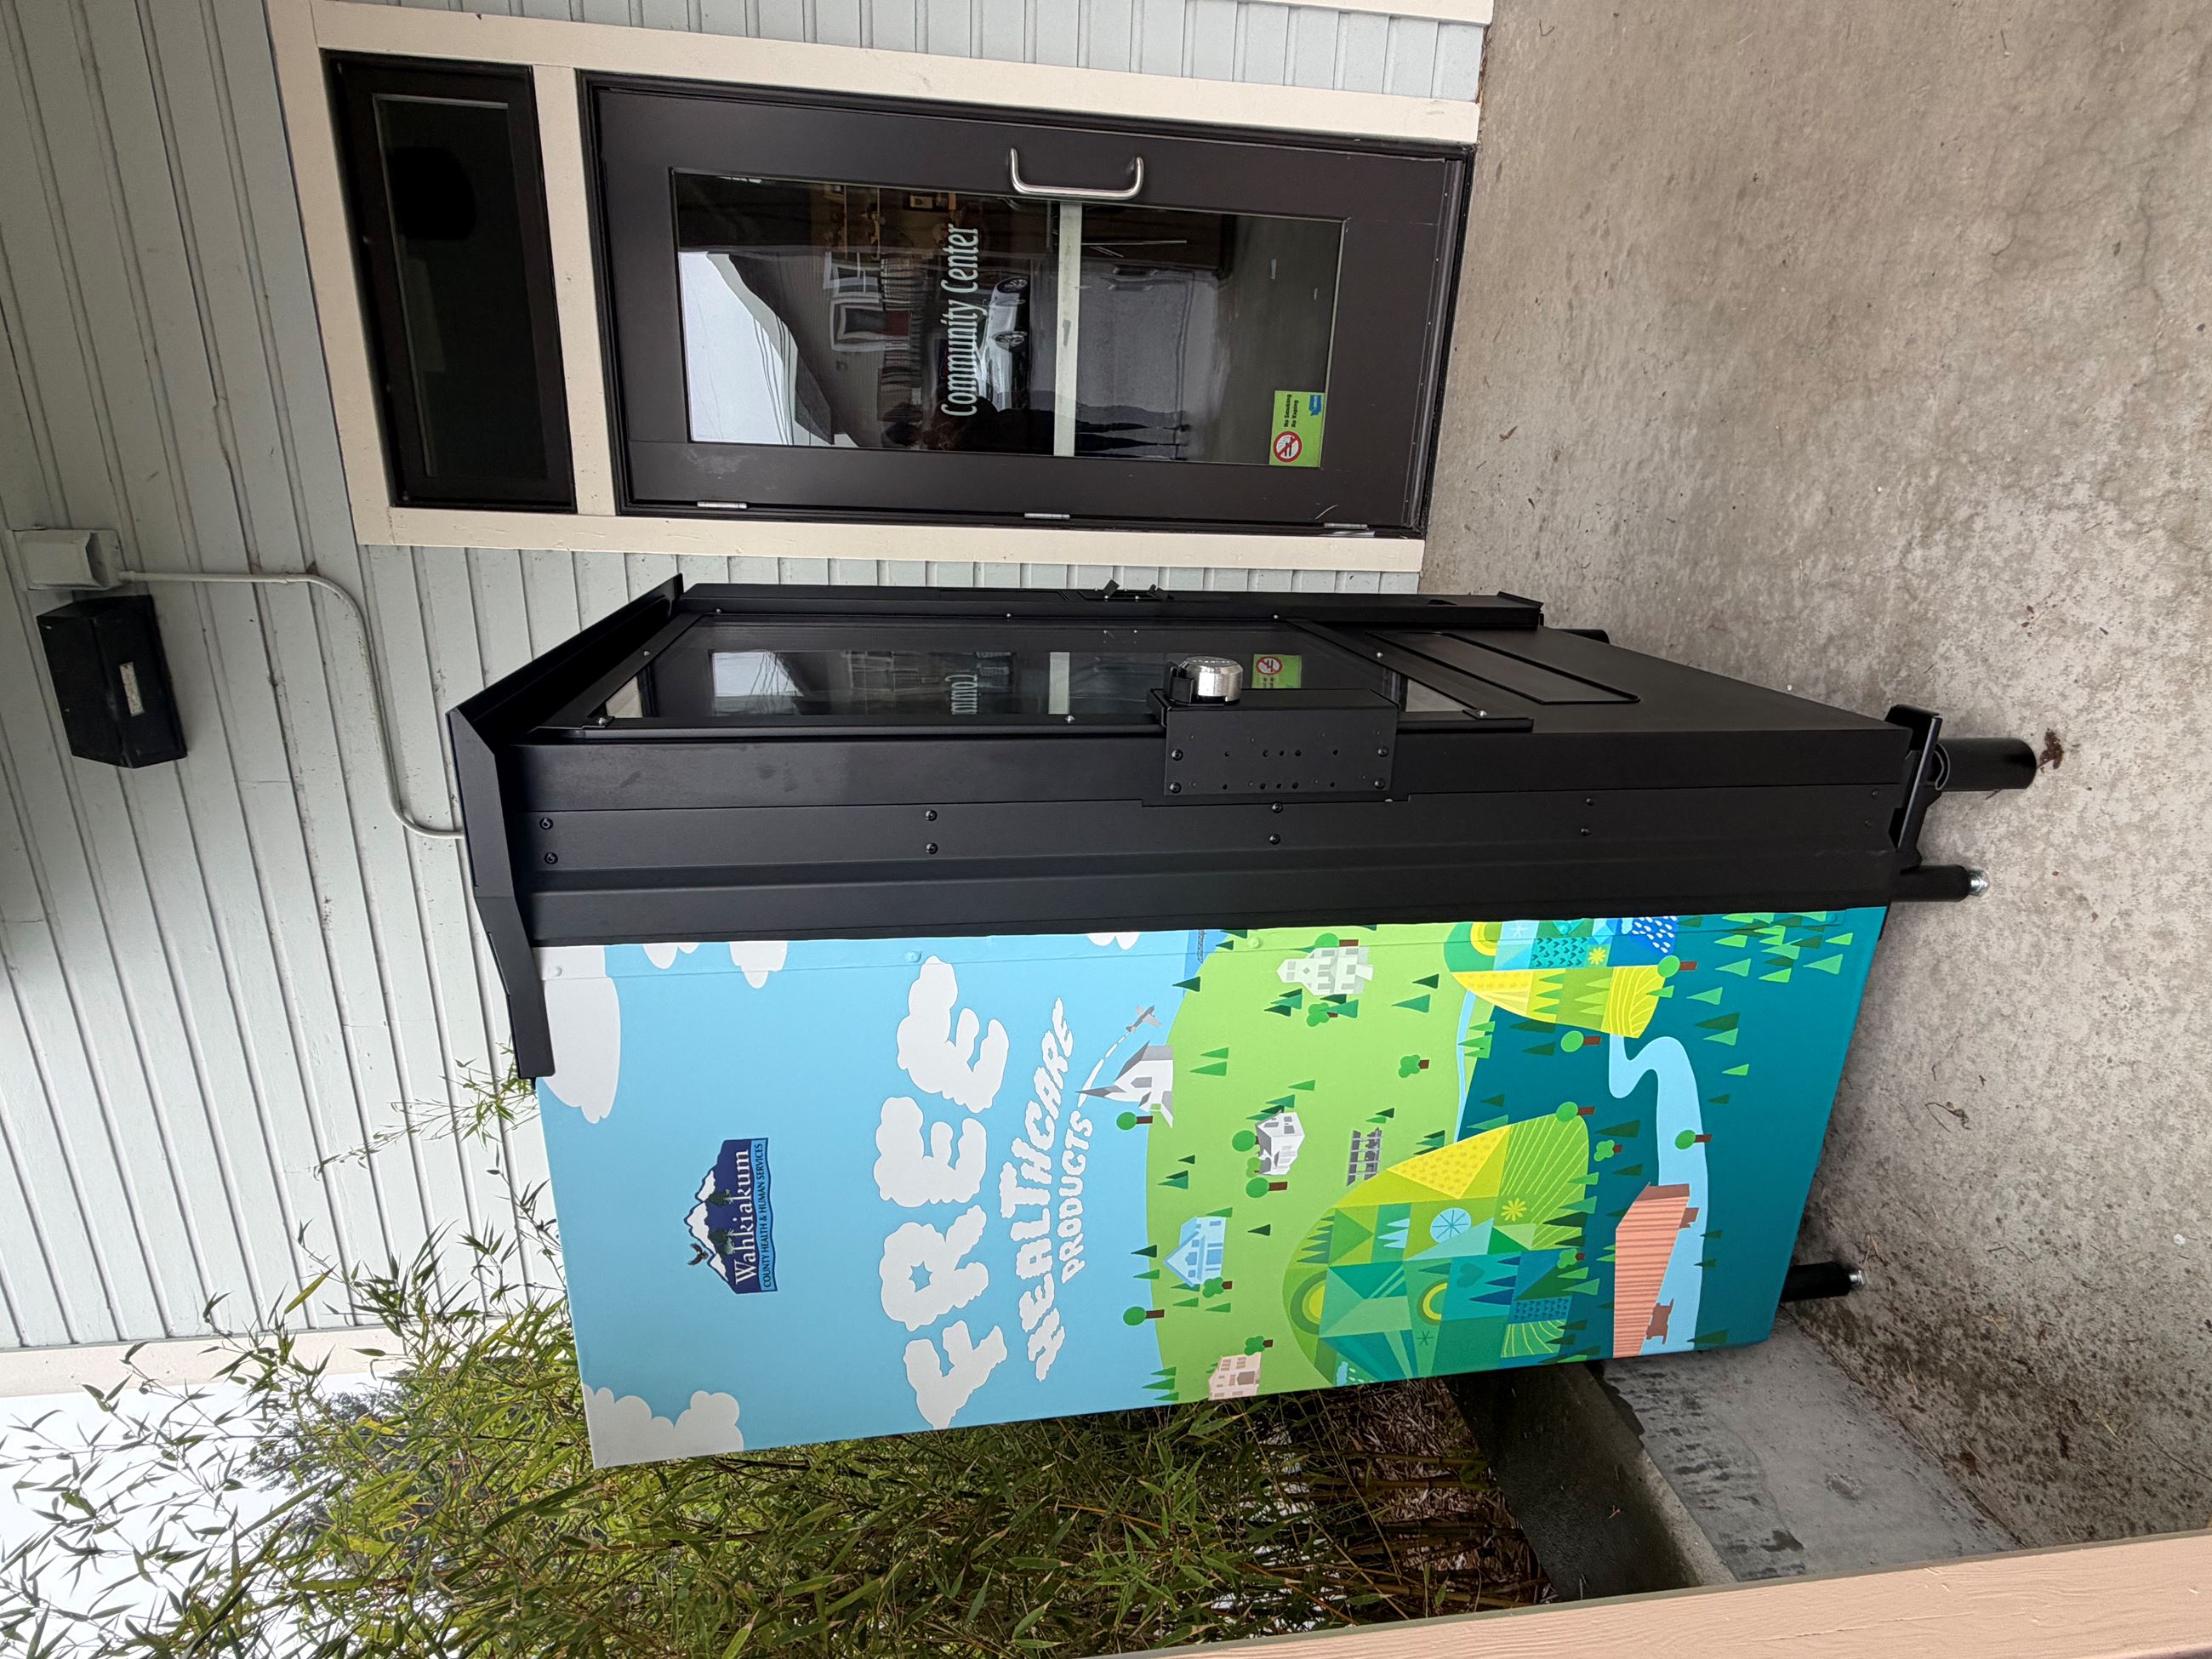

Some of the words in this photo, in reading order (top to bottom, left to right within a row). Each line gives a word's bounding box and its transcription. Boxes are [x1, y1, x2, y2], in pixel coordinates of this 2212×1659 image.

[941, 224, 979, 293] Center
[940, 299, 988, 415] Community
[755, 1143, 766, 1180] SERVICES
[758, 1182, 767, 1212] HUMAN
[873, 955, 1009, 1431] FREE
[999, 996, 1074, 1382] HEALTHCARE
[1057, 1109, 1094, 1284] PRODUCTS
[733, 1149, 756, 1285] Wahkiakum
[760, 1223, 769, 1252] HEALTH
[762, 1254, 772, 1287] COUNTY
